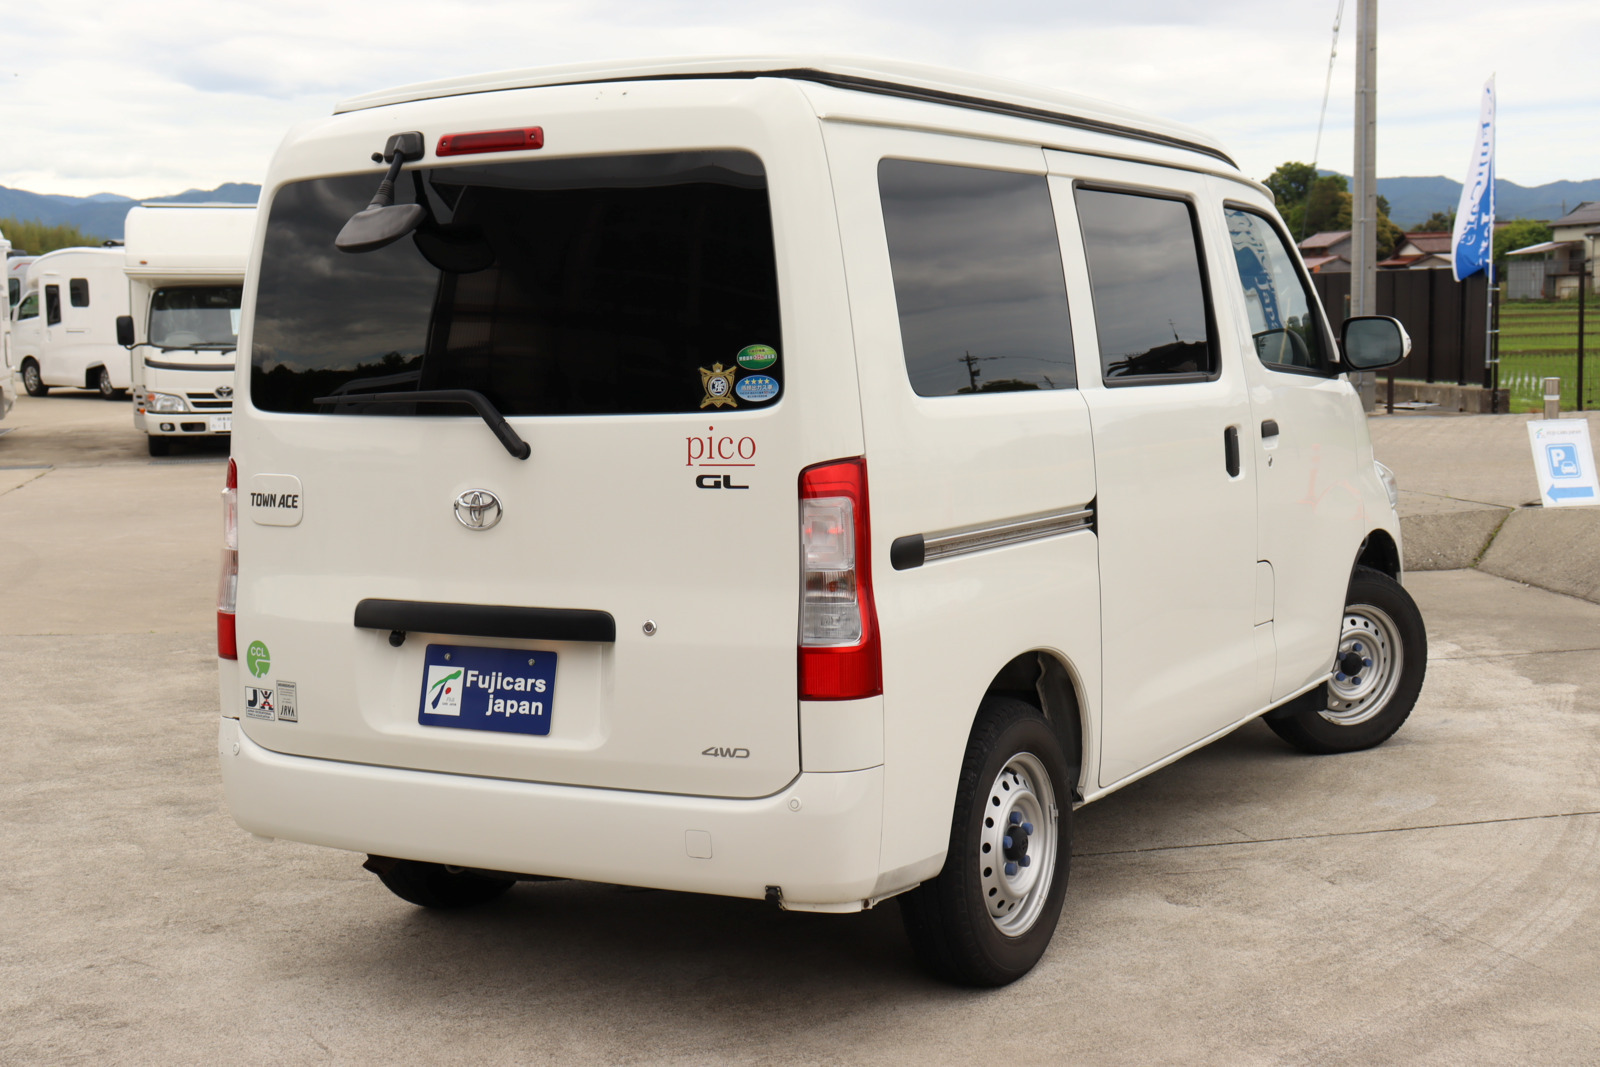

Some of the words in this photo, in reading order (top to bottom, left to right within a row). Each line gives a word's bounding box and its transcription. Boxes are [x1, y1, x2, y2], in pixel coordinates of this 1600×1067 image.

[685, 425, 757, 467] pico
[1550, 449, 1565, 467] P
[695, 474, 750, 489] GL
[250, 493, 276, 507] TOWN
[278, 494, 299, 508] ACE
[251, 647, 266, 657] CCL
[465, 669, 547, 694] Fujicars
[280, 705, 295, 717] JRVA
[485, 694, 543, 718] japan
[701, 746, 750, 759] 4WD
